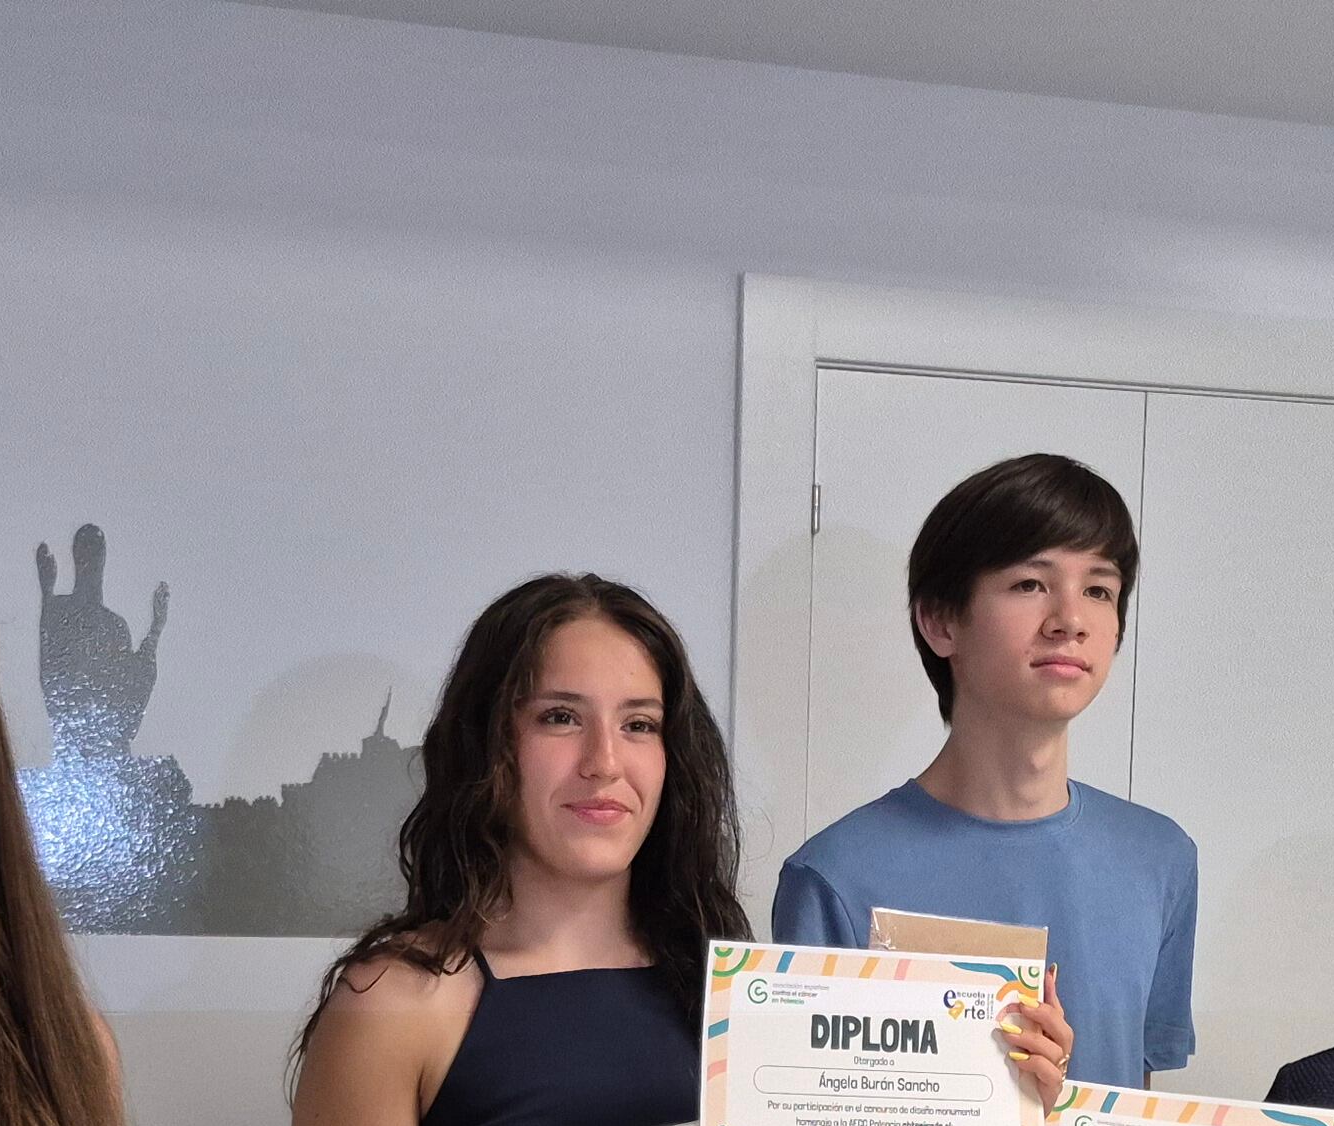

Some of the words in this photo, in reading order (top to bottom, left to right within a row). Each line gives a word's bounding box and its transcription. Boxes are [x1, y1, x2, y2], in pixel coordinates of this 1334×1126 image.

[810, 1014, 938, 1055] DIPLOMA
[853, 1056, 888, 1067] Otorgado
[819, 1071, 858, 1093] Ángela
[861, 1076, 895, 1092] Burón
[897, 1078, 941, 1093] Sancho
[767, 1101, 780, 1110] Por
[782, 1103, 792, 1111] su
[793, 1102, 843, 1113] participación
[855, 1104, 862, 1112] el
[863, 1105, 898, 1114] concurso
[899, 1105, 909, 1114] de
[910, 1105, 935, 1115] diseño
[935, 1107, 981, 1117] monumental
[840, 1119, 848, 1126] la
